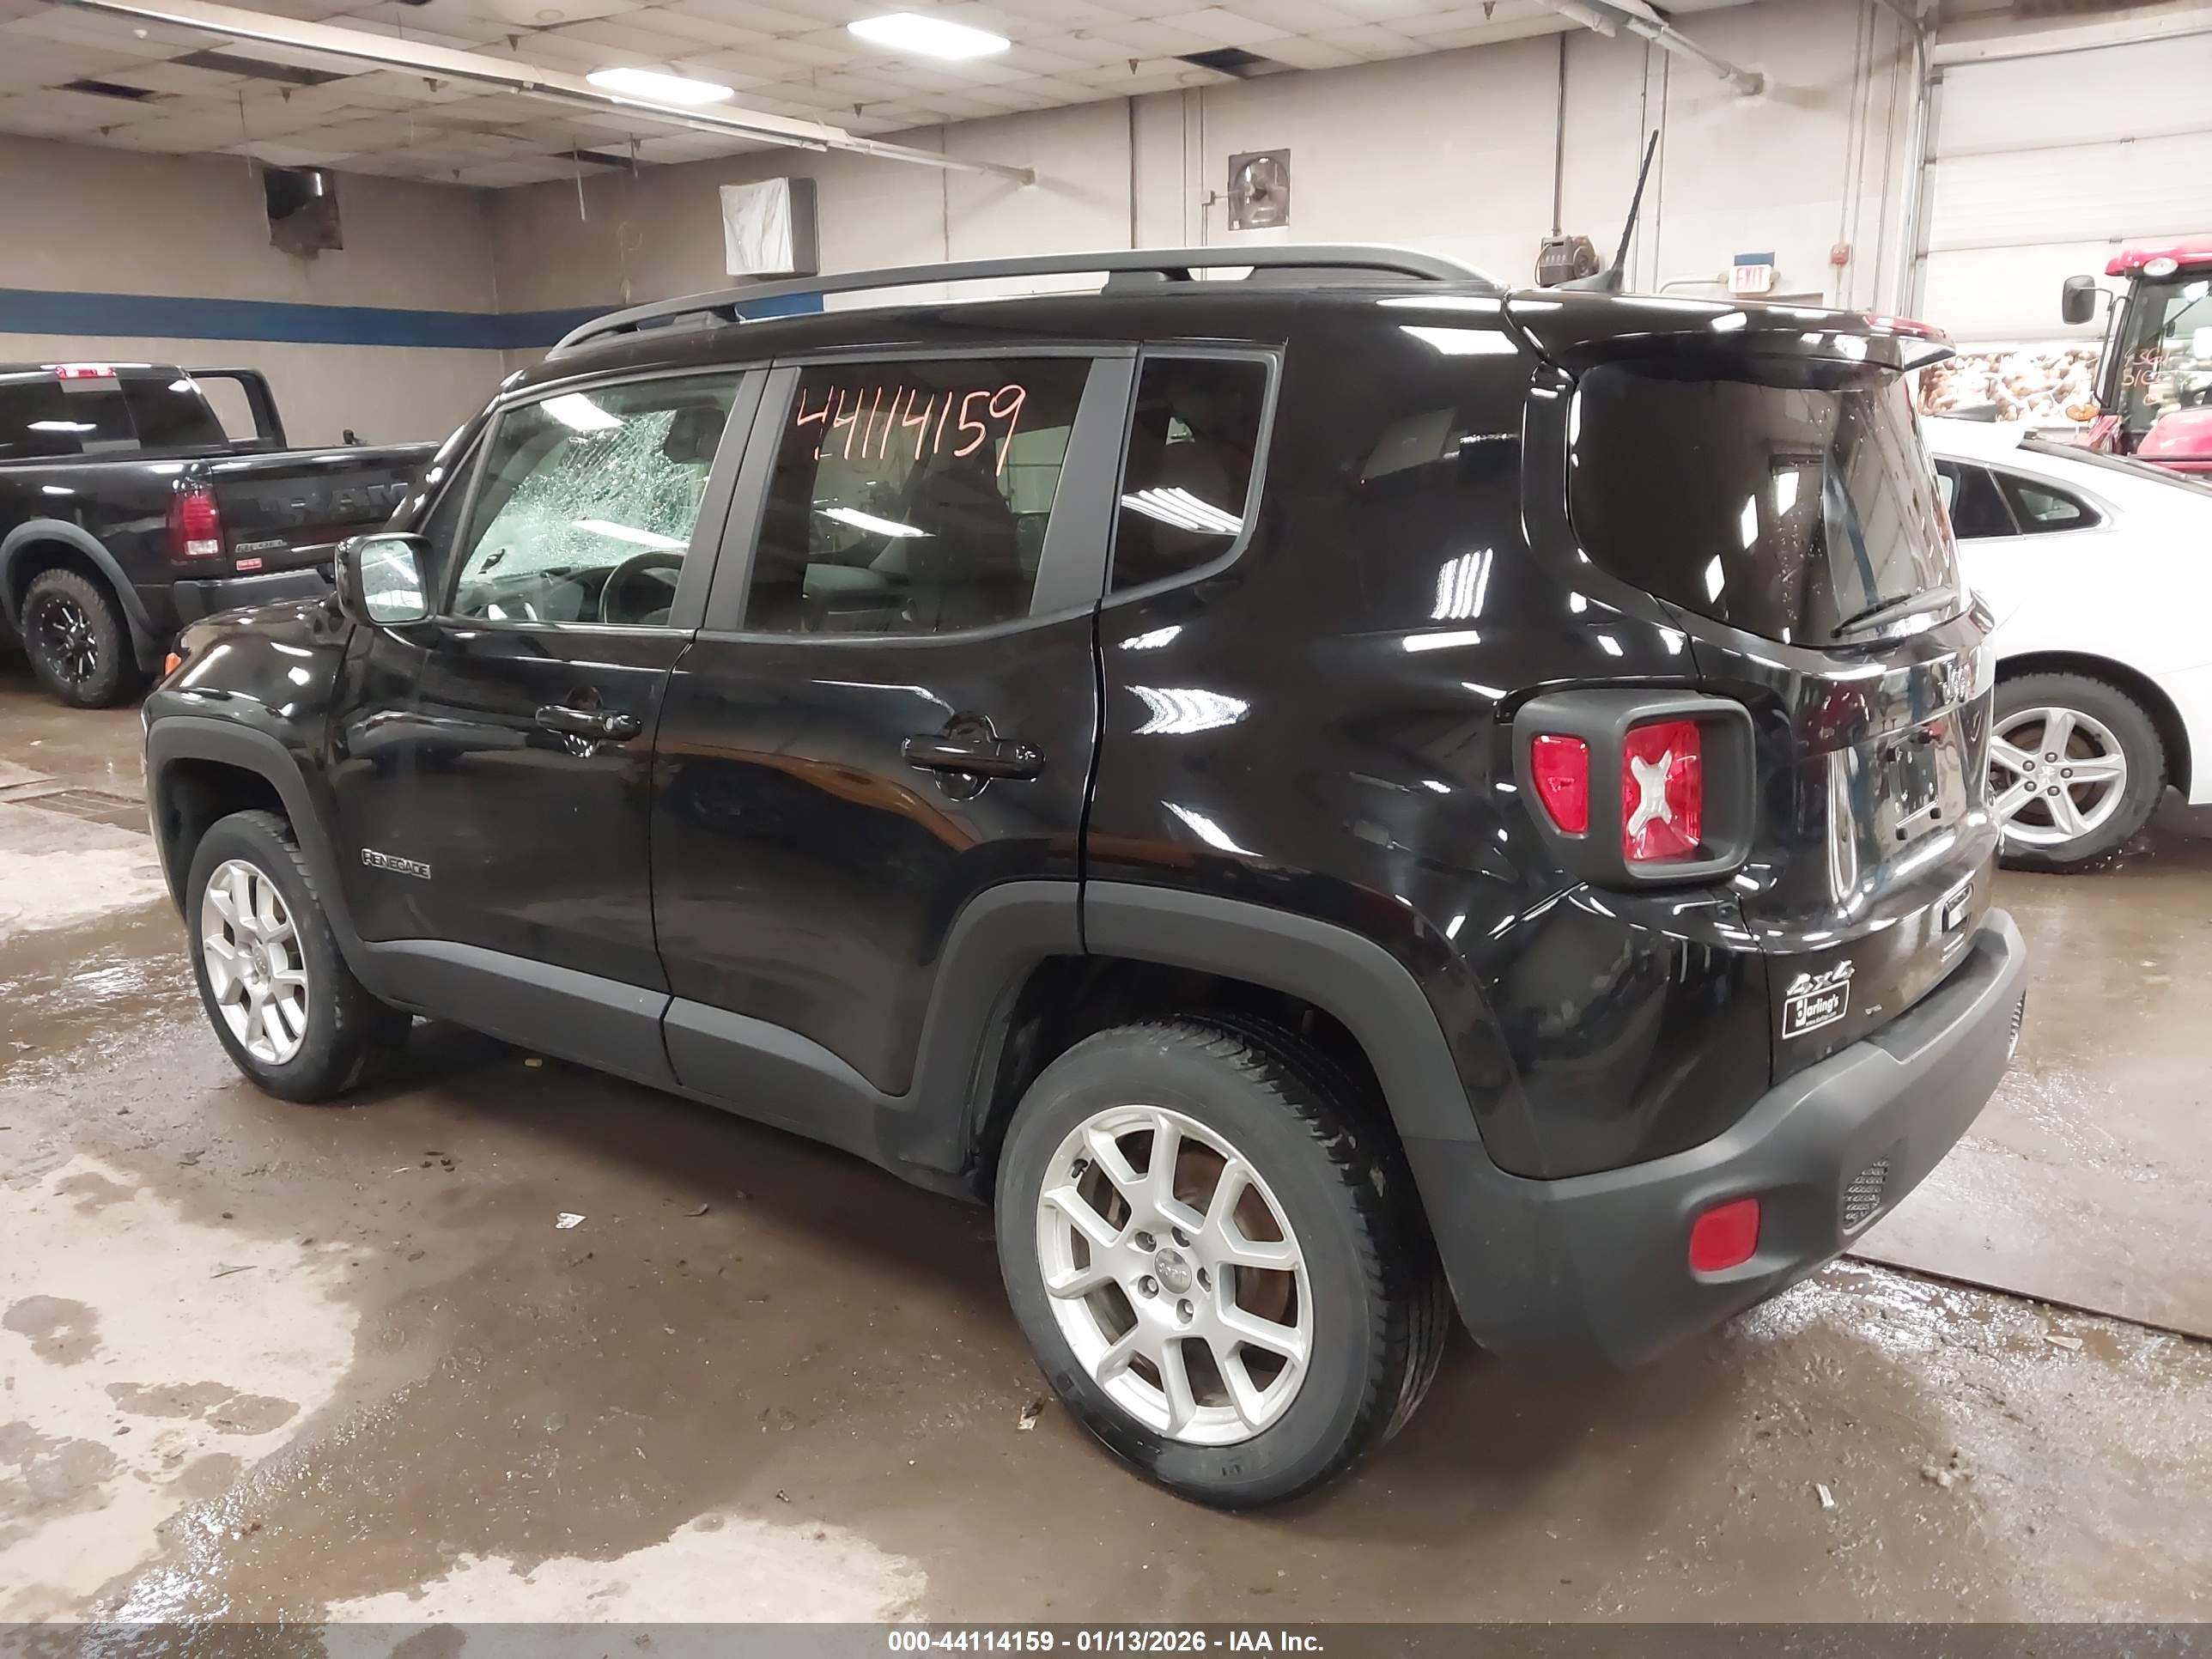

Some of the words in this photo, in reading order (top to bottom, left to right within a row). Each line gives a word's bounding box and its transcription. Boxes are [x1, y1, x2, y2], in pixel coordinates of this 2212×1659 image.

[1735, 266, 1765, 290] EXIT
[797, 384, 1027, 477] 44114159
[362, 848, 431, 879] RENEGADE
